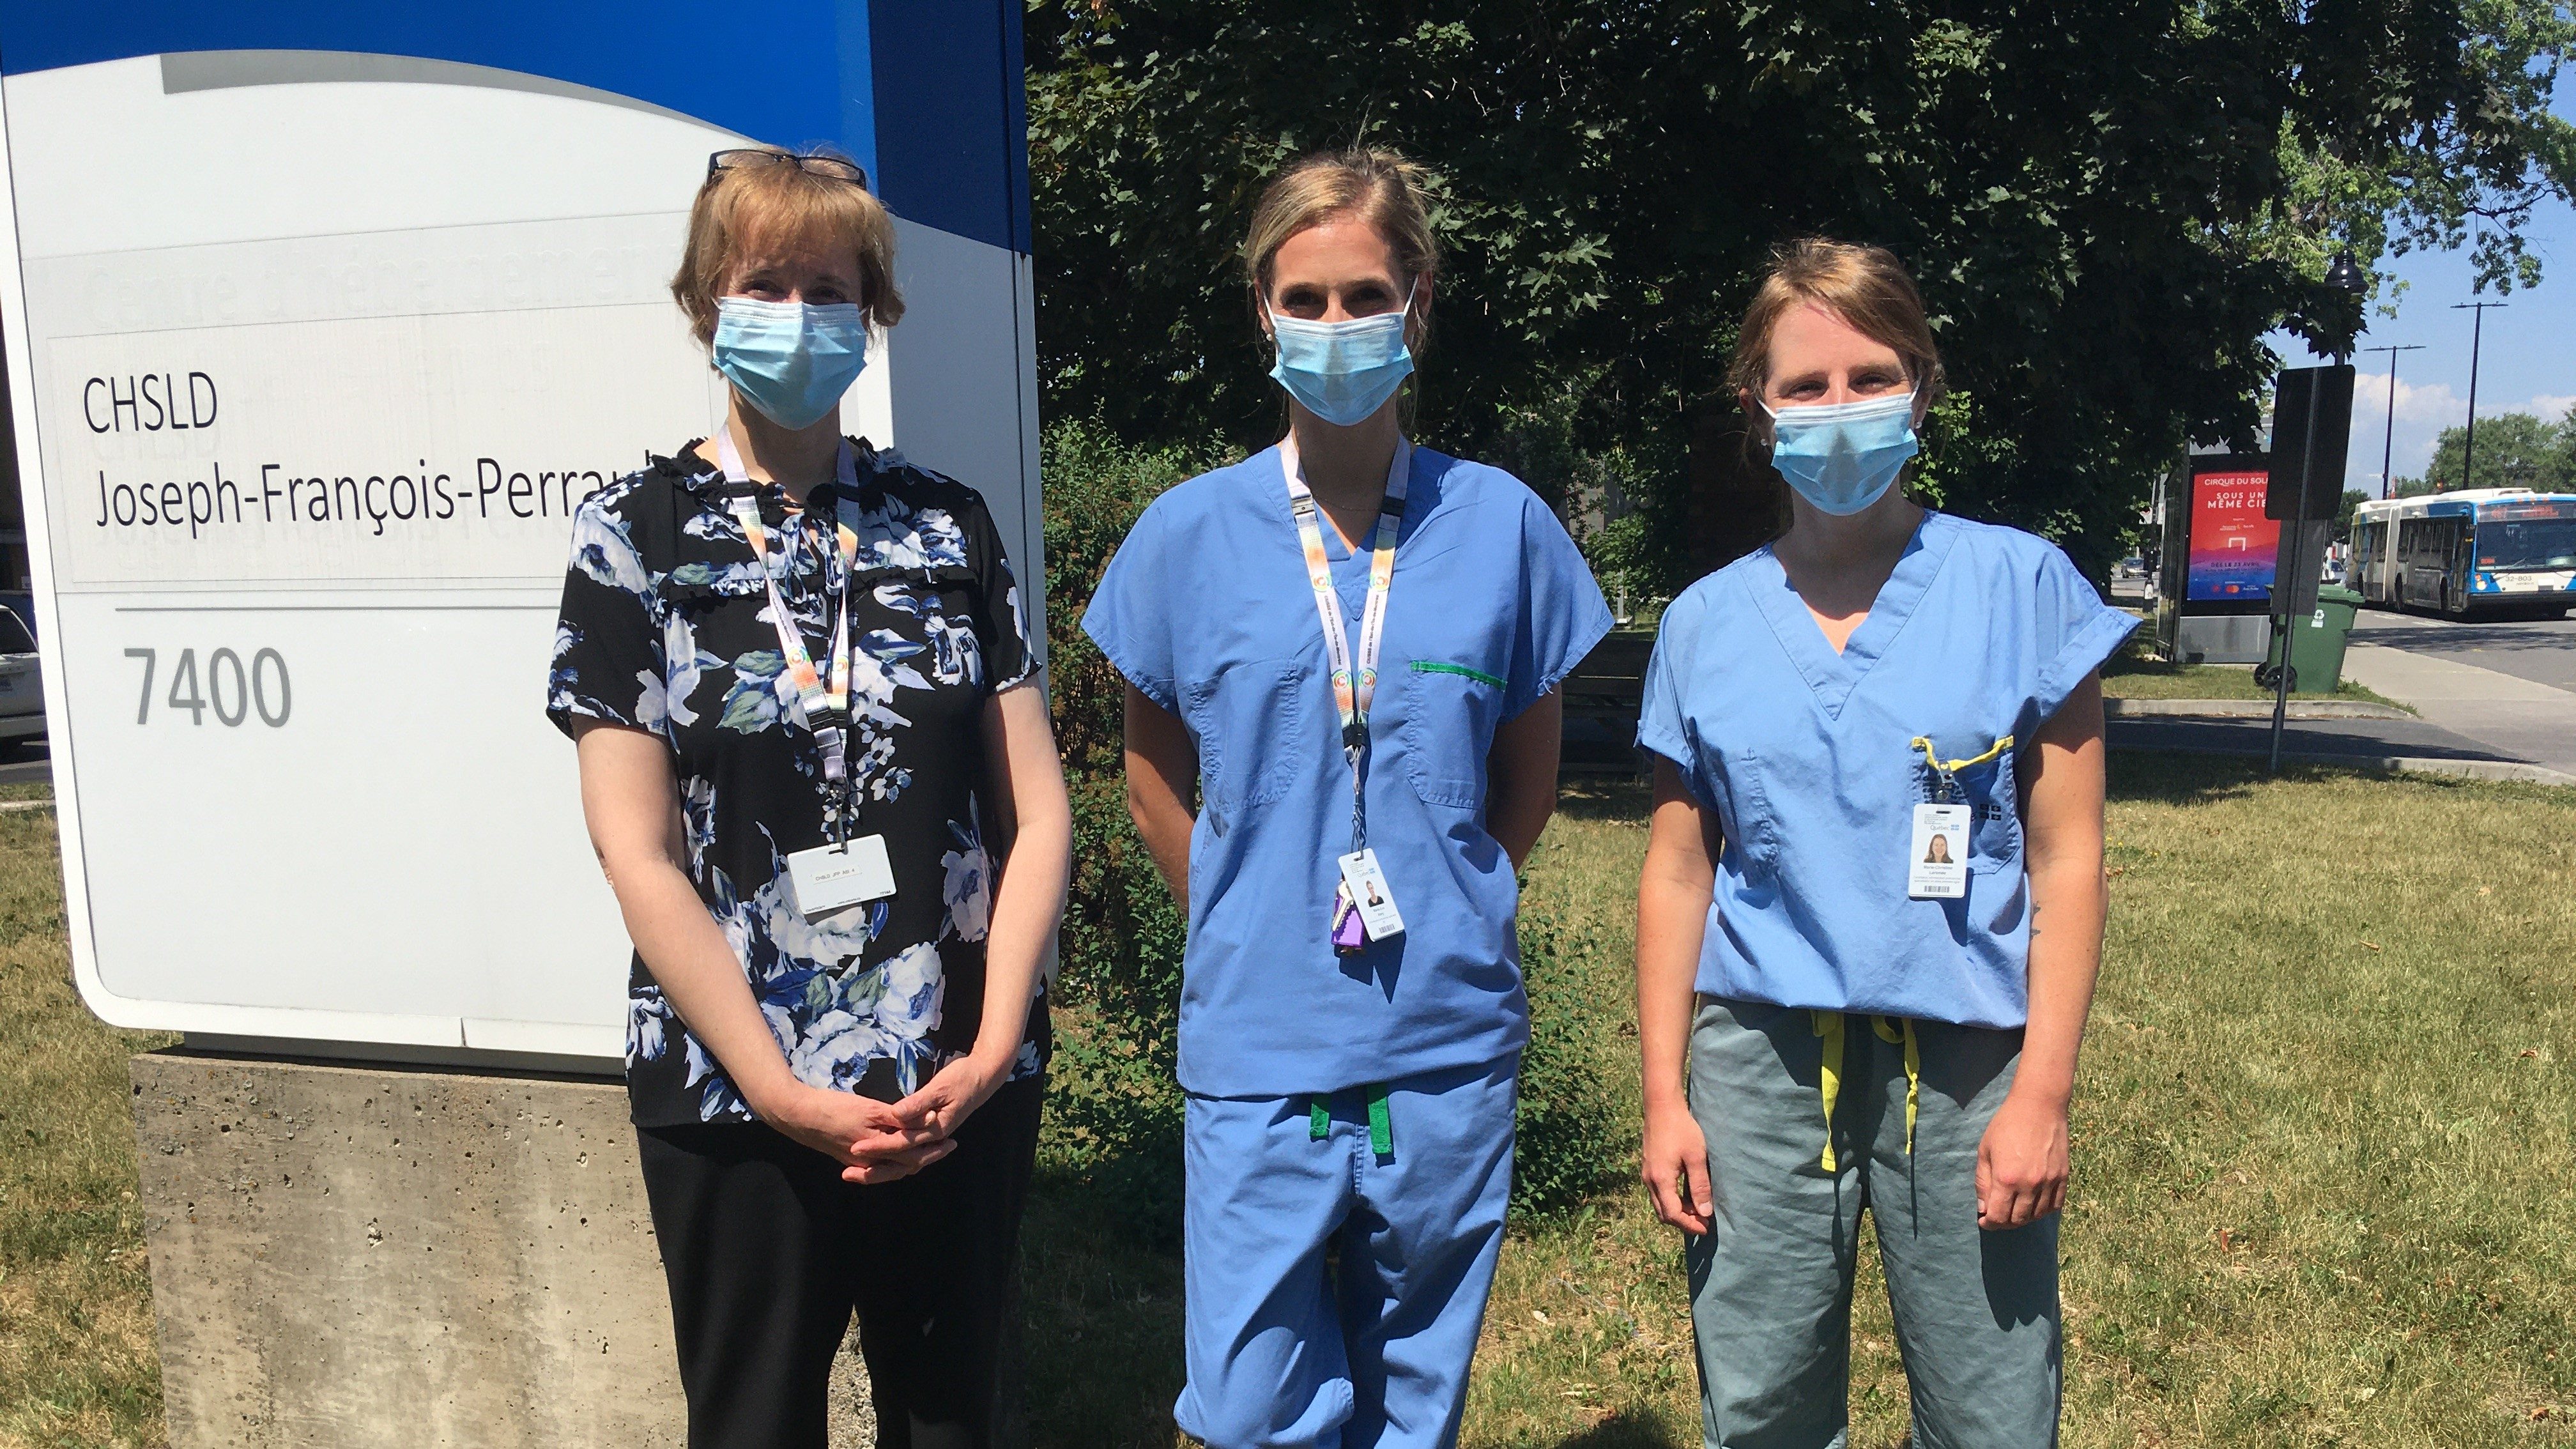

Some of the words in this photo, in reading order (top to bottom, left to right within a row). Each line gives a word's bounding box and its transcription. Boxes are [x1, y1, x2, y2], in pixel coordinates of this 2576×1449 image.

[84, 372, 217, 433] CHSLD
[97, 448, 650, 539] Joseph-François-Perra
[2204, 478, 2235, 486] CIRQUE
[2207, 498, 2242, 508] MÊME
[2248, 499, 2266, 507] CIE
[125, 647, 291, 728] 7400
